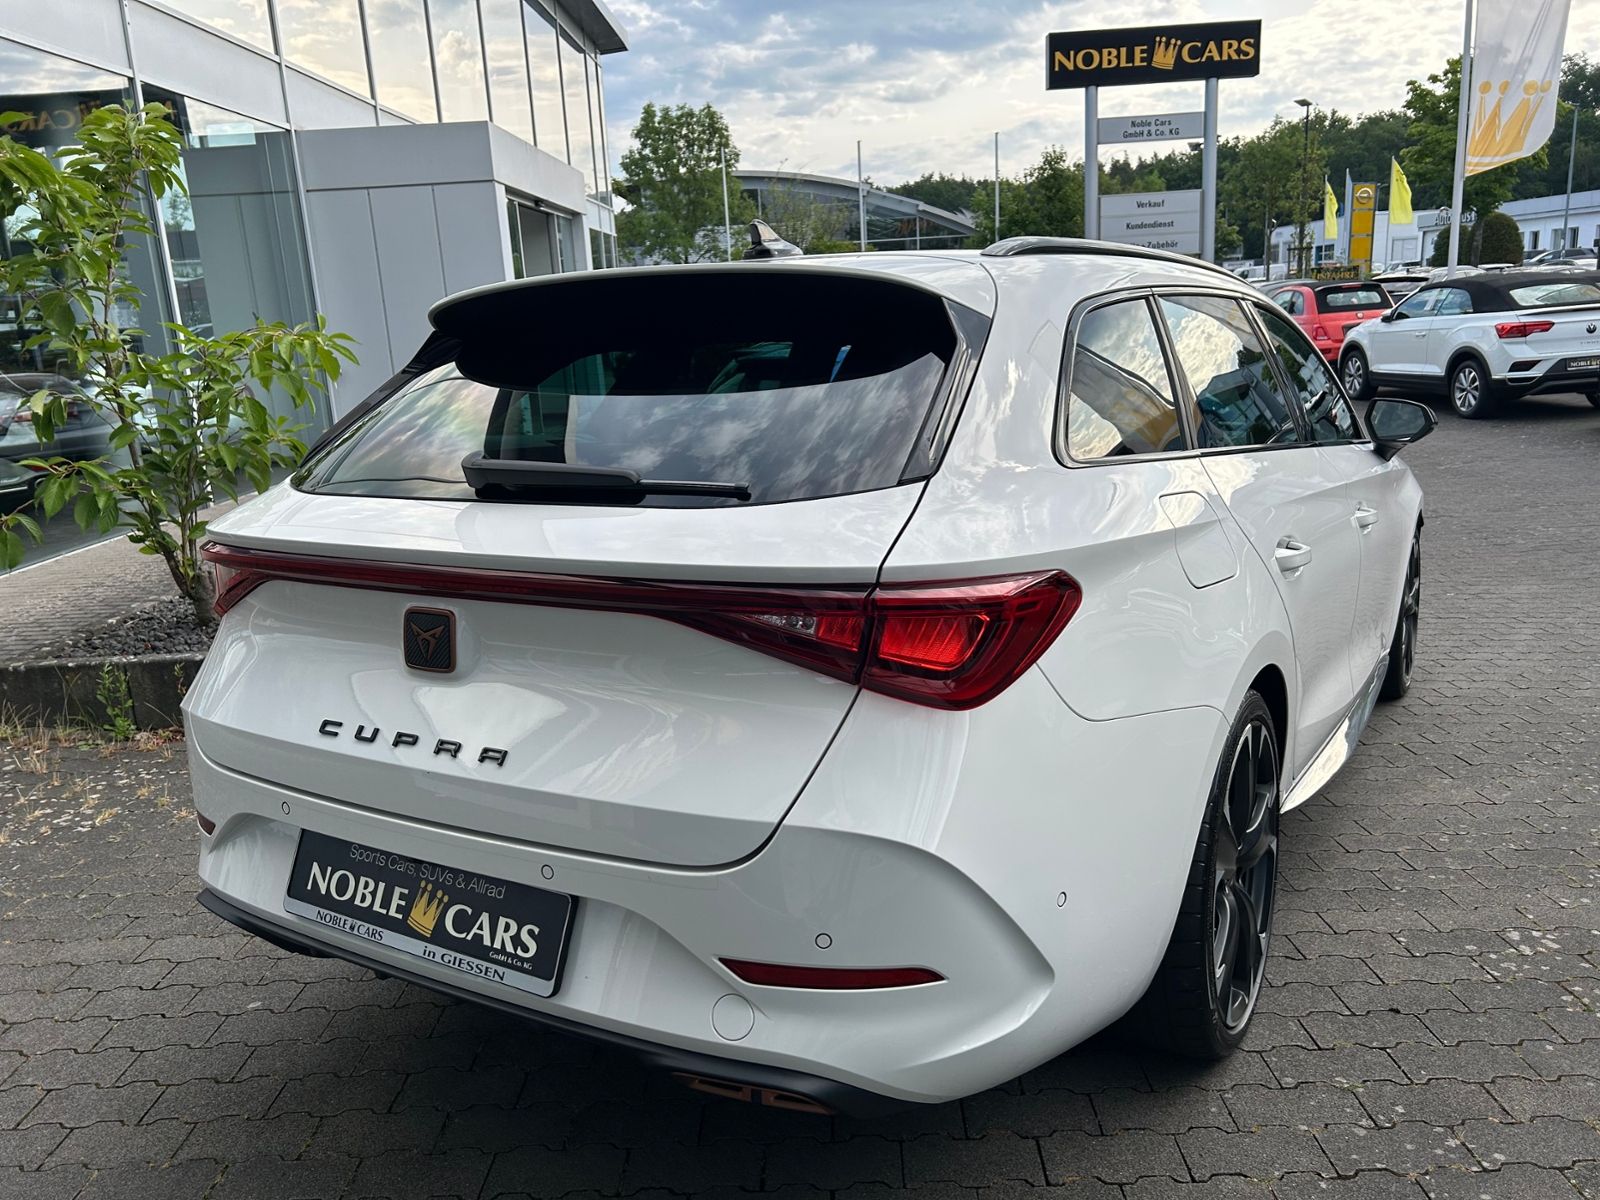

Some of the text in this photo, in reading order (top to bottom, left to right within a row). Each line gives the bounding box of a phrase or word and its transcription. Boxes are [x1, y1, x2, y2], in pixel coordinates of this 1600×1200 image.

[1054, 38, 1256, 72] NOBLE CARS
[1122, 127, 1180, 138] GmbH & Co. KG
[1130, 118, 1172, 128] Noble Cars
[1136, 199, 1165, 209] Verkauf
[1434, 211, 1471, 225] Autous
[1126, 219, 1174, 230] Kundendienst
[318, 719, 509, 767] CUPRA
[350, 844, 507, 900] Sports Cars, SUVs & Allrad
[306, 861, 541, 959] NOBLE CARS
[315, 909, 384, 942] NOBLE CARS
[422, 945, 507, 982] in GIESSEN
